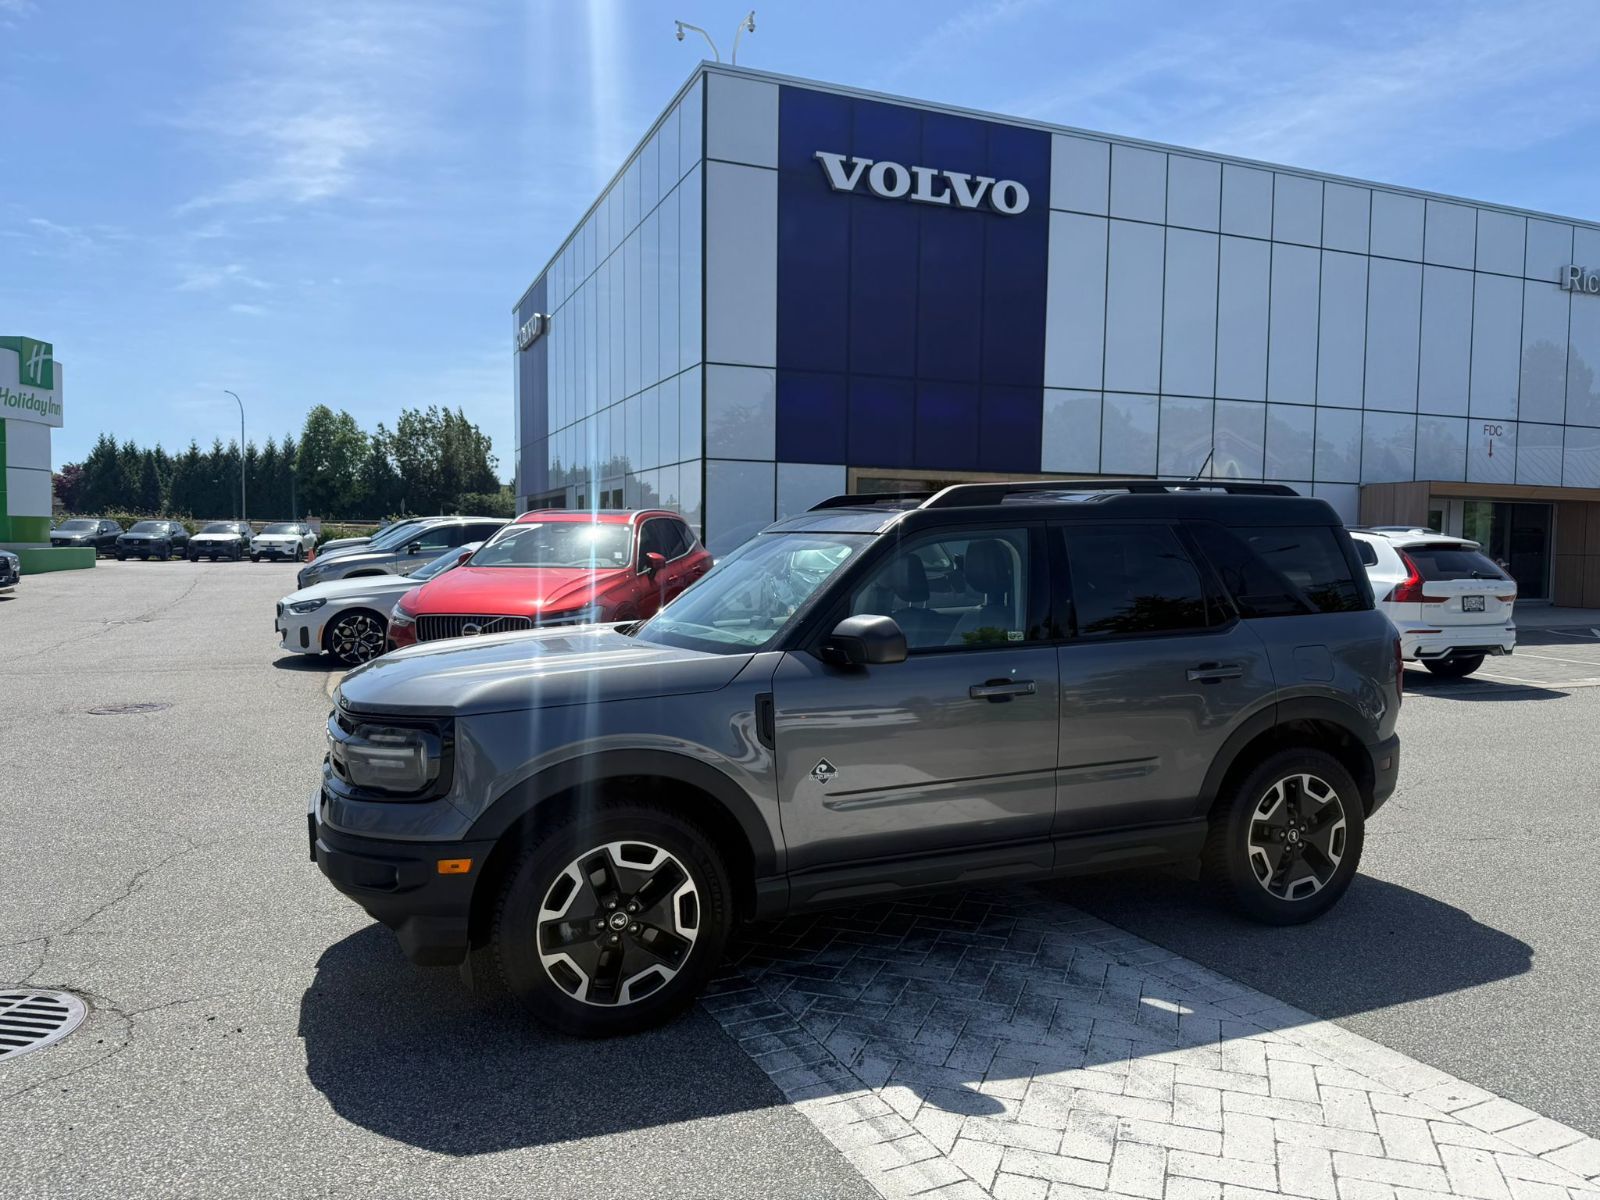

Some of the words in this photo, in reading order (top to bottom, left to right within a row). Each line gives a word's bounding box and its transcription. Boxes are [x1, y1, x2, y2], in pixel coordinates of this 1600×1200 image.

[813, 151, 1030, 215] VOLVO
[0, 387, 48, 417] Holiday
[48, 395, 62, 416] Inn
[1483, 424, 1503, 437] FDC
